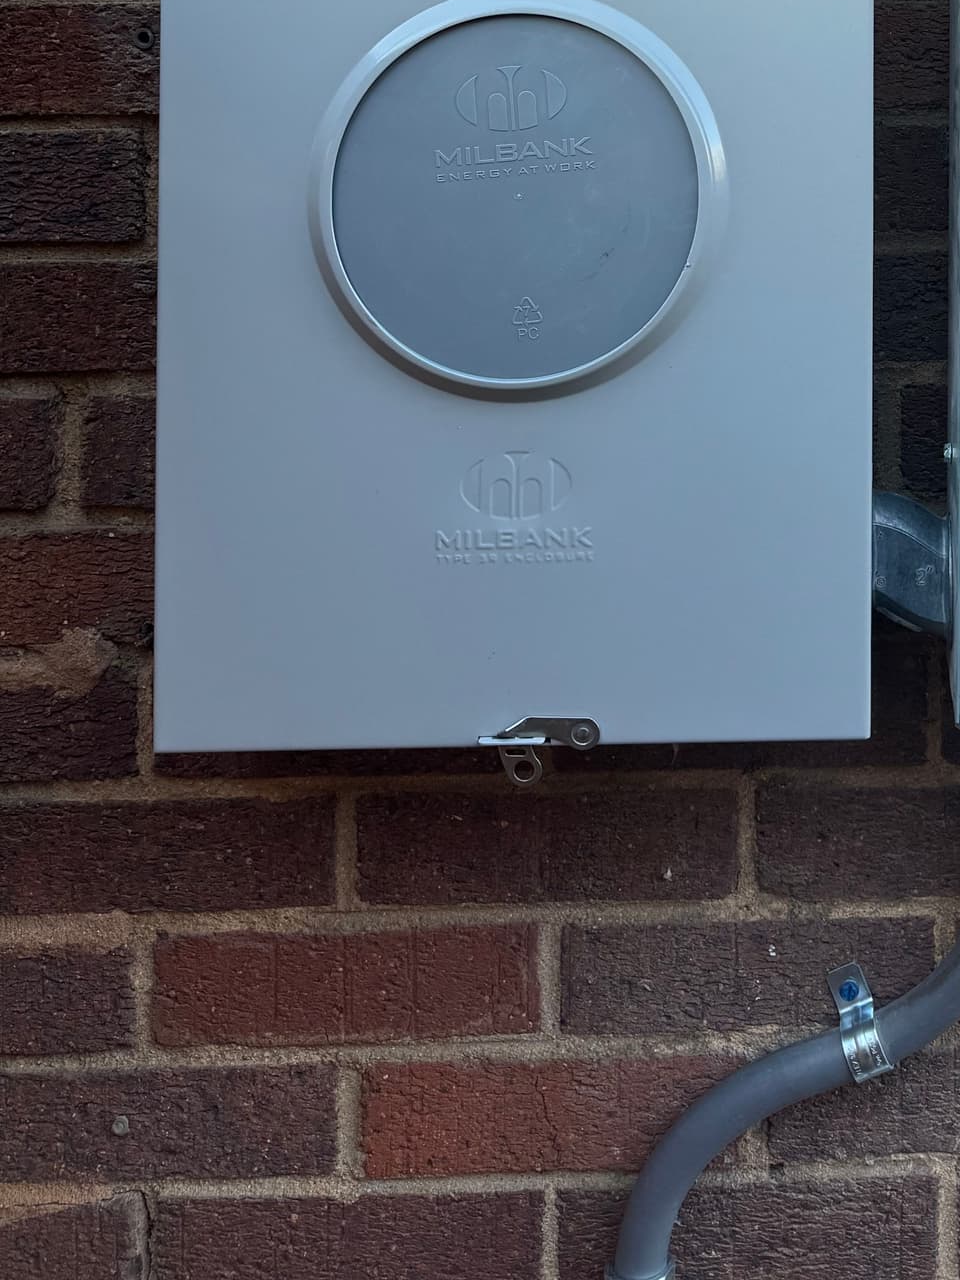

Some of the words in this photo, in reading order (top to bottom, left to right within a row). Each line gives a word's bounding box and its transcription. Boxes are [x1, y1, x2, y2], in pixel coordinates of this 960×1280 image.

[433, 136, 593, 168] MILBANK
[436, 167, 512, 183] ENERGY
[518, 165, 539, 175] AT
[545, 160, 597, 173] WORK
[518, 327, 539, 340] PC
[435, 526, 593, 551] MILBANK
[436, 553, 472, 565] TYPE
